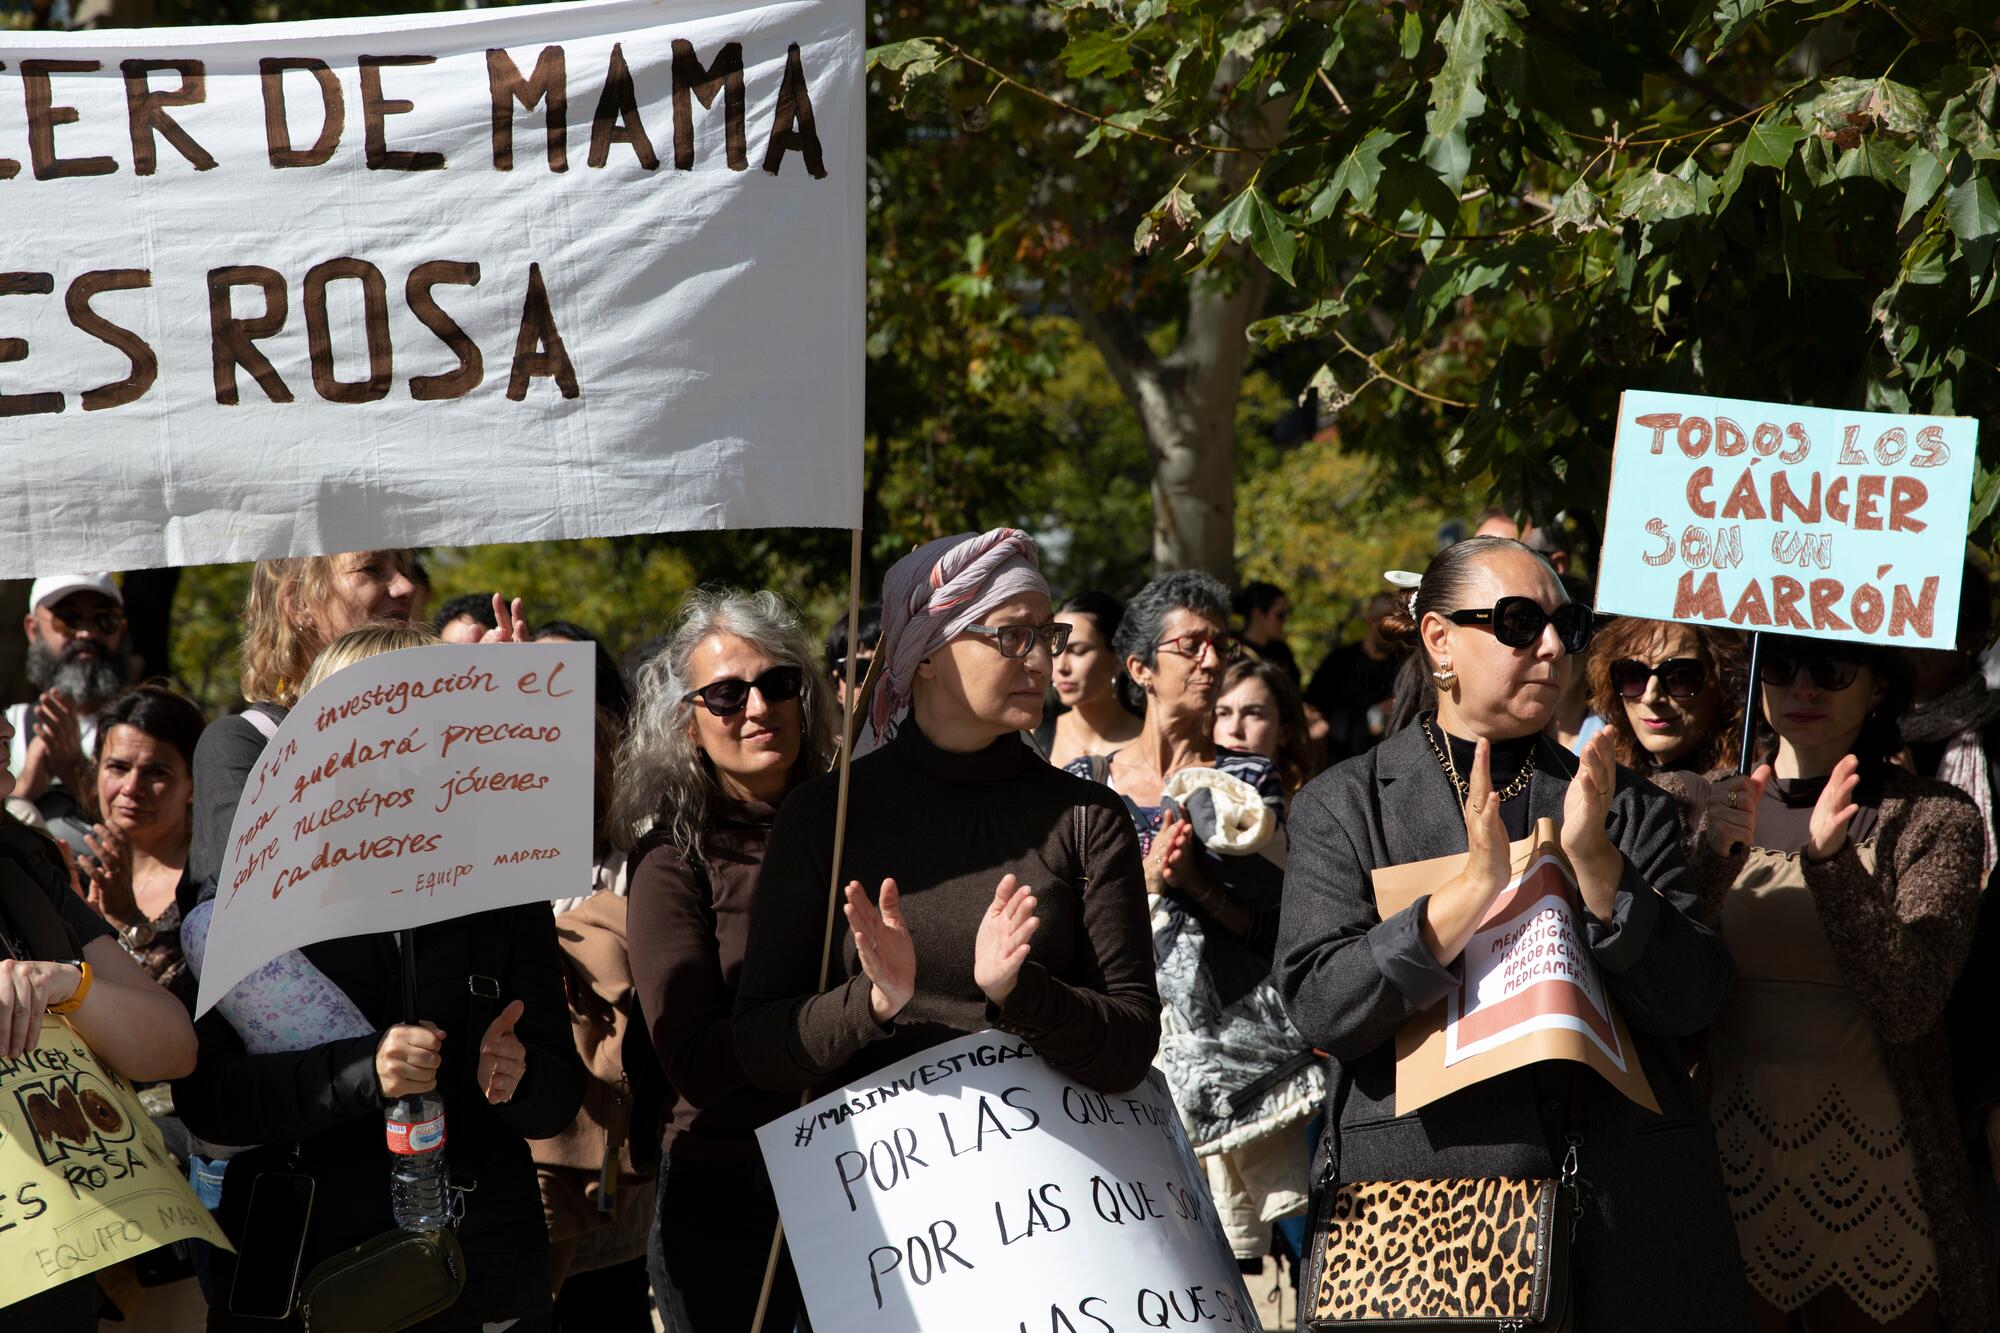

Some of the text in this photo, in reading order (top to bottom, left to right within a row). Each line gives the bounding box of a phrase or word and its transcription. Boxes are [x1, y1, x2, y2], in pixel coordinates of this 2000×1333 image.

[0, 37, 830, 181] ER DE MAMA
[206, 255, 581, 406] ROSA
[1634, 412, 1952, 468] TODOS LOS
[1685, 456, 1930, 534] CÁNCER
[1641, 516, 1833, 570] SON UN
[1672, 563, 1941, 639] MARRÓN
[314, 664, 499, 733] investigación
[517, 661, 575, 698] el
[234, 804, 281, 865] rosa
[288, 727, 428, 804] quedará
[224, 836, 281, 910] sobre
[292, 786, 416, 843] nuestros
[271, 832, 443, 900] cadaveres
[493, 847, 562, 866] MADRID
[1491, 918, 1533, 953] MENOS
[794, 1042, 1041, 1148] #MASINVESTIGAC
[62, 1147, 149, 1201] ROSA
[834, 1126, 931, 1212] POR
[938, 1086, 1041, 1158] LAS
[1062, 1085, 1125, 1127] QUE
[34, 1219, 144, 1278] EQUIPO
[868, 1219, 975, 1311] POR
[995, 1183, 1071, 1246] LAS
[1090, 1175, 1165, 1226] QUE
[1019, 1296, 1116, 1333] AS
[1137, 1285, 1217, 1330] QUE
